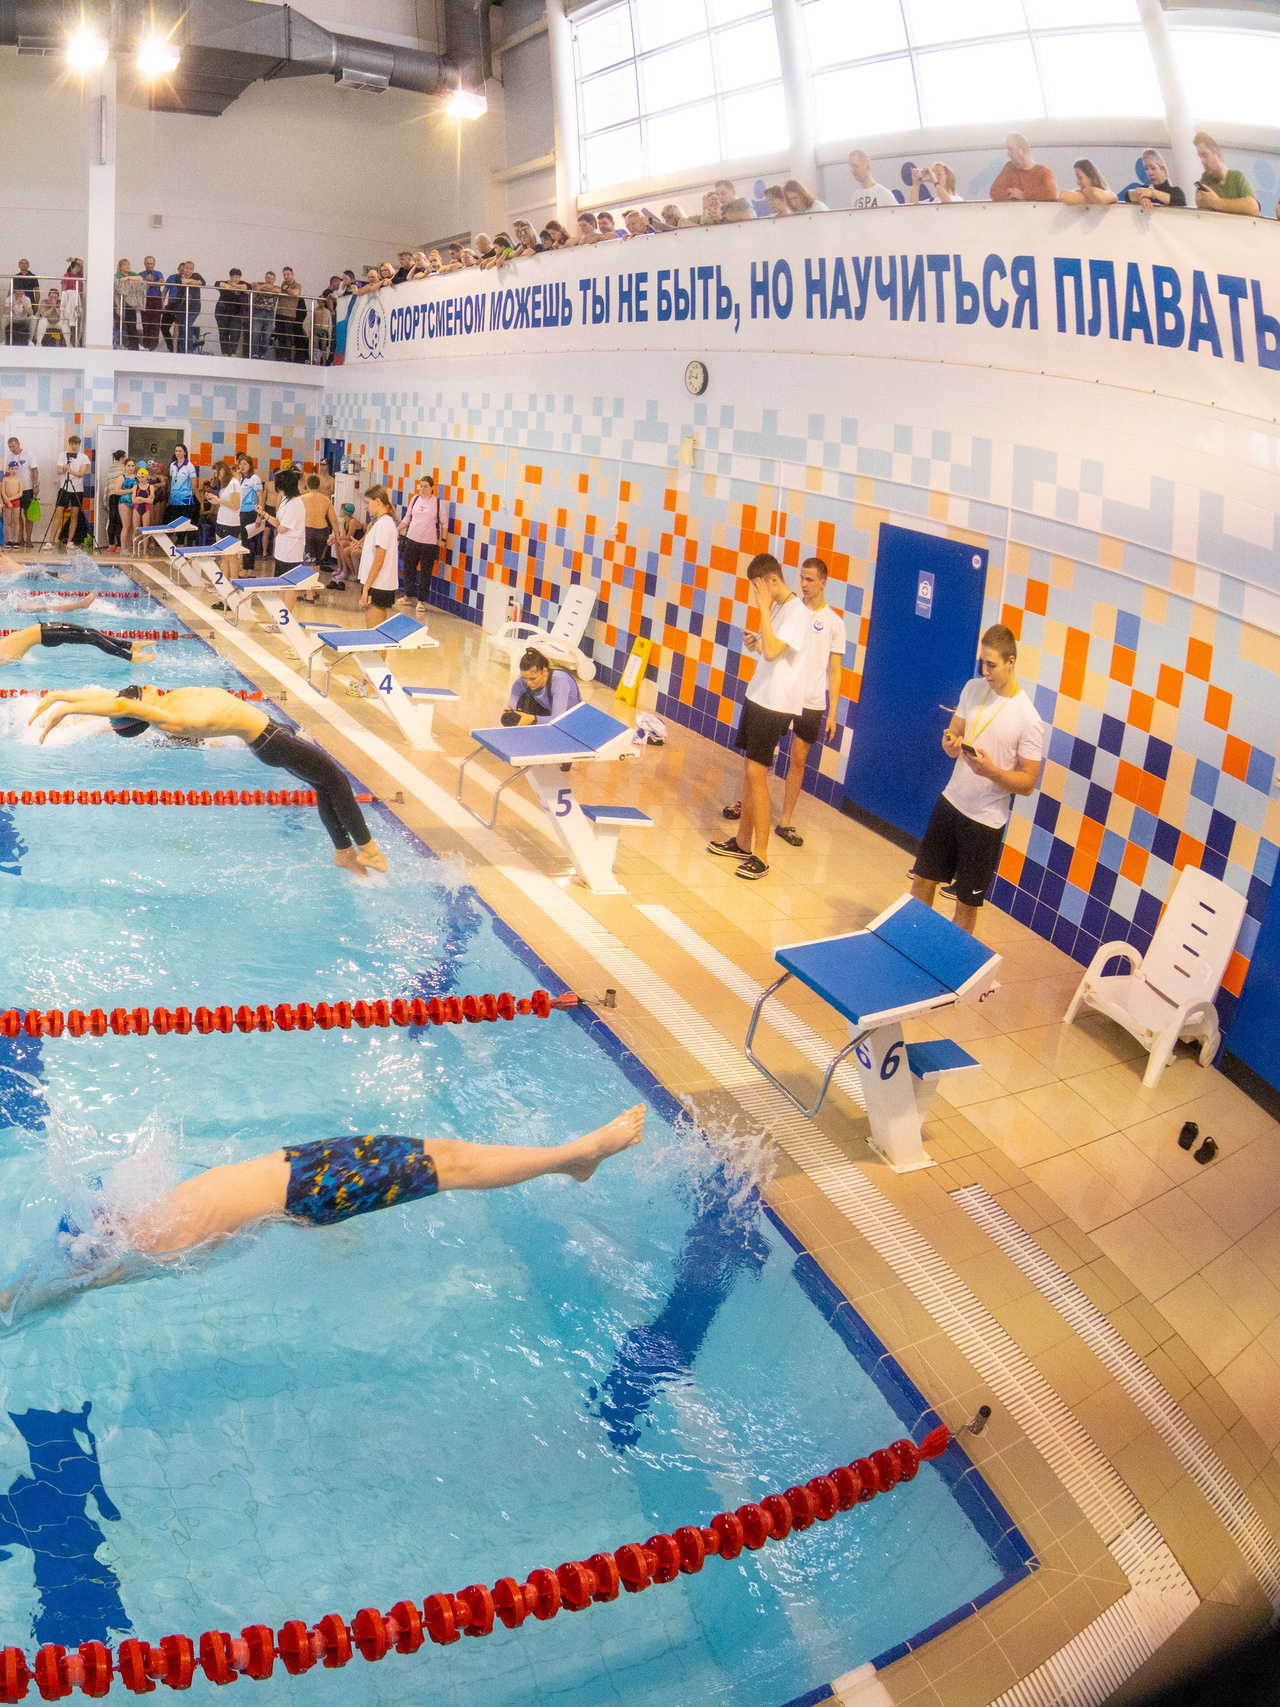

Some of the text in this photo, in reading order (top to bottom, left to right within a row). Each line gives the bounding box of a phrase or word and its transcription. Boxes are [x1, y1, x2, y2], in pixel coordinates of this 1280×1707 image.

[389, 293, 486, 343] СПОРТСМЕНОМ
[489, 282, 573, 331] МОЖЕШЬ
[579, 276, 610, 325] ТЫ
[618, 271, 648, 323] НЕ
[657, 264, 741, 335] БЫТЬ,
[750, 258, 794, 320] НО
[804, 253, 1039, 330] НАУЧИТЬСЯ
[1053, 256, 1280, 372] ПЛАВАТЬ
[150, 443, 157, 454] 6
[170, 546, 177, 557] 1
[215, 572, 224, 584] 2
[279, 609, 289, 625] 3
[379, 674, 393, 694] 4
[555, 788, 572, 817] 5
[880, 1041, 905, 1080] 6
